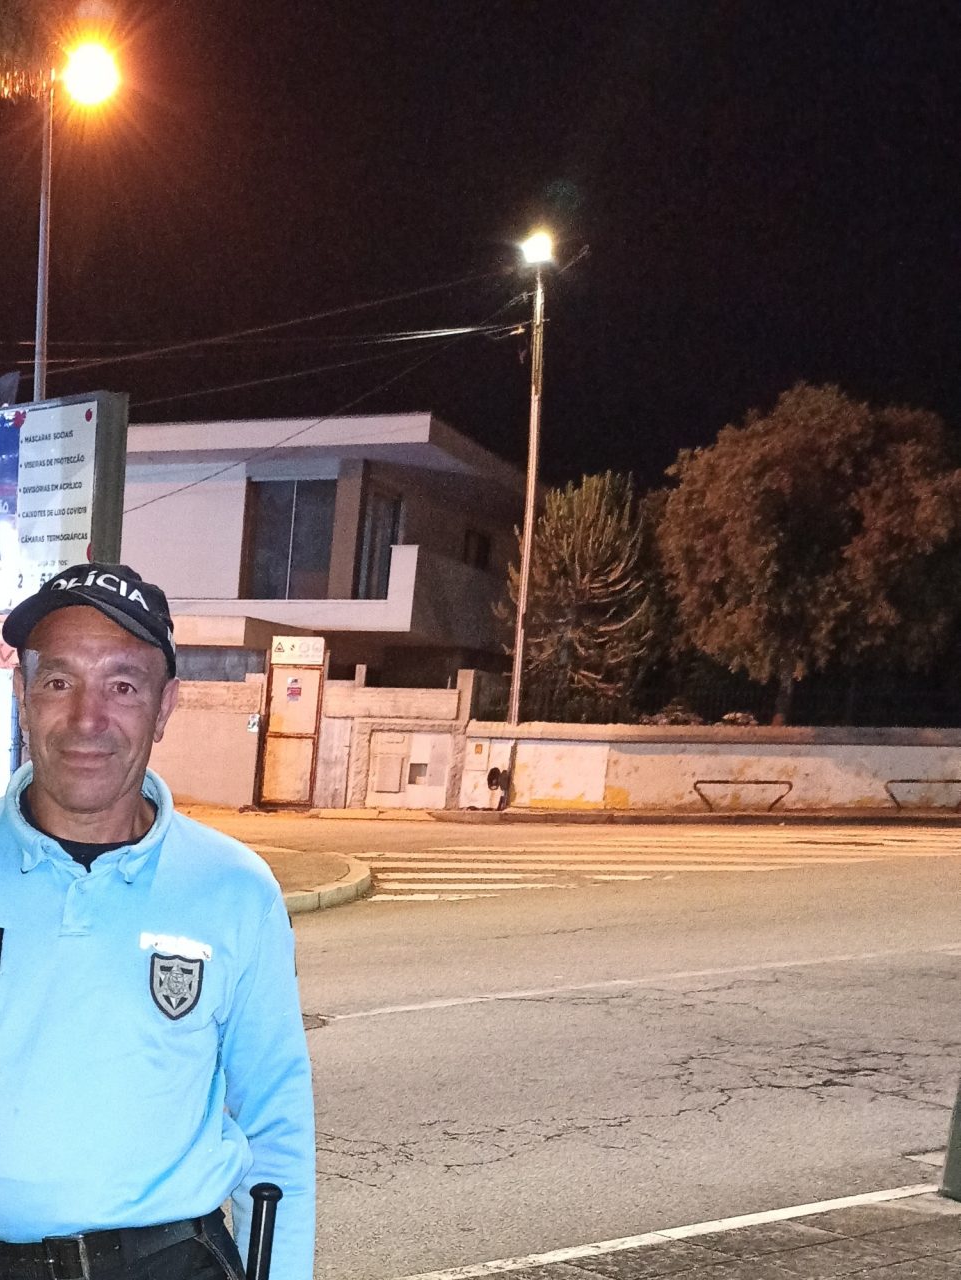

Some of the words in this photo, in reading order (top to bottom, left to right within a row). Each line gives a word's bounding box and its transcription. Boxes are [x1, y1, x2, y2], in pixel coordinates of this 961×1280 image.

[46, 458, 53, 467] DE
[22, 510, 46, 519] CAIXOTES
[47, 509, 53, 517] DE
[54, 507, 66, 516] LIXO
[20, 534, 45, 544] CÂMARAS
[46, 532, 88, 543] TERMOGRÁFICAS
[51, 570, 150, 611] OLÍCIA
